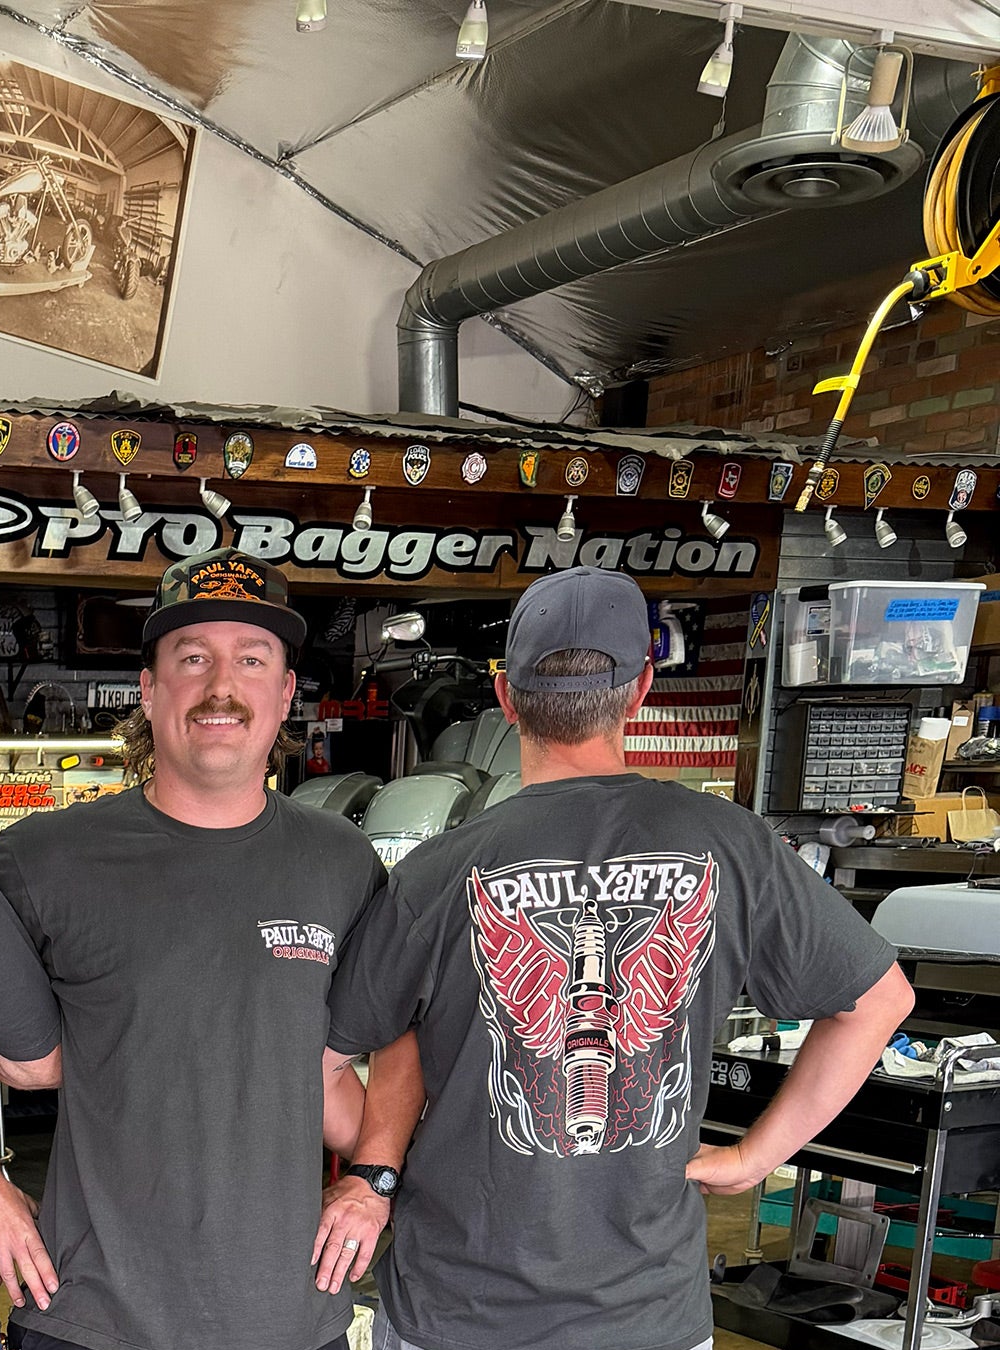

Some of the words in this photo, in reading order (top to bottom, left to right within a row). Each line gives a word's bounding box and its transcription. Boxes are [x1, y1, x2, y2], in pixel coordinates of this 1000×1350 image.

[38, 505, 218, 556] PYO
[233, 514, 513, 575] Bagger
[524, 526, 757, 573] Nation
[190, 562, 225, 585] PAUL
[227, 560, 265, 587] YAFFE
[7, 771, 53, 784] Yaffe's
[489, 869, 588, 917] PAUL
[260, 926, 306, 948] PAUL
[618, 911, 699, 1041] ARIZONA
[567, 1037, 610, 1049] ORIGINALS
